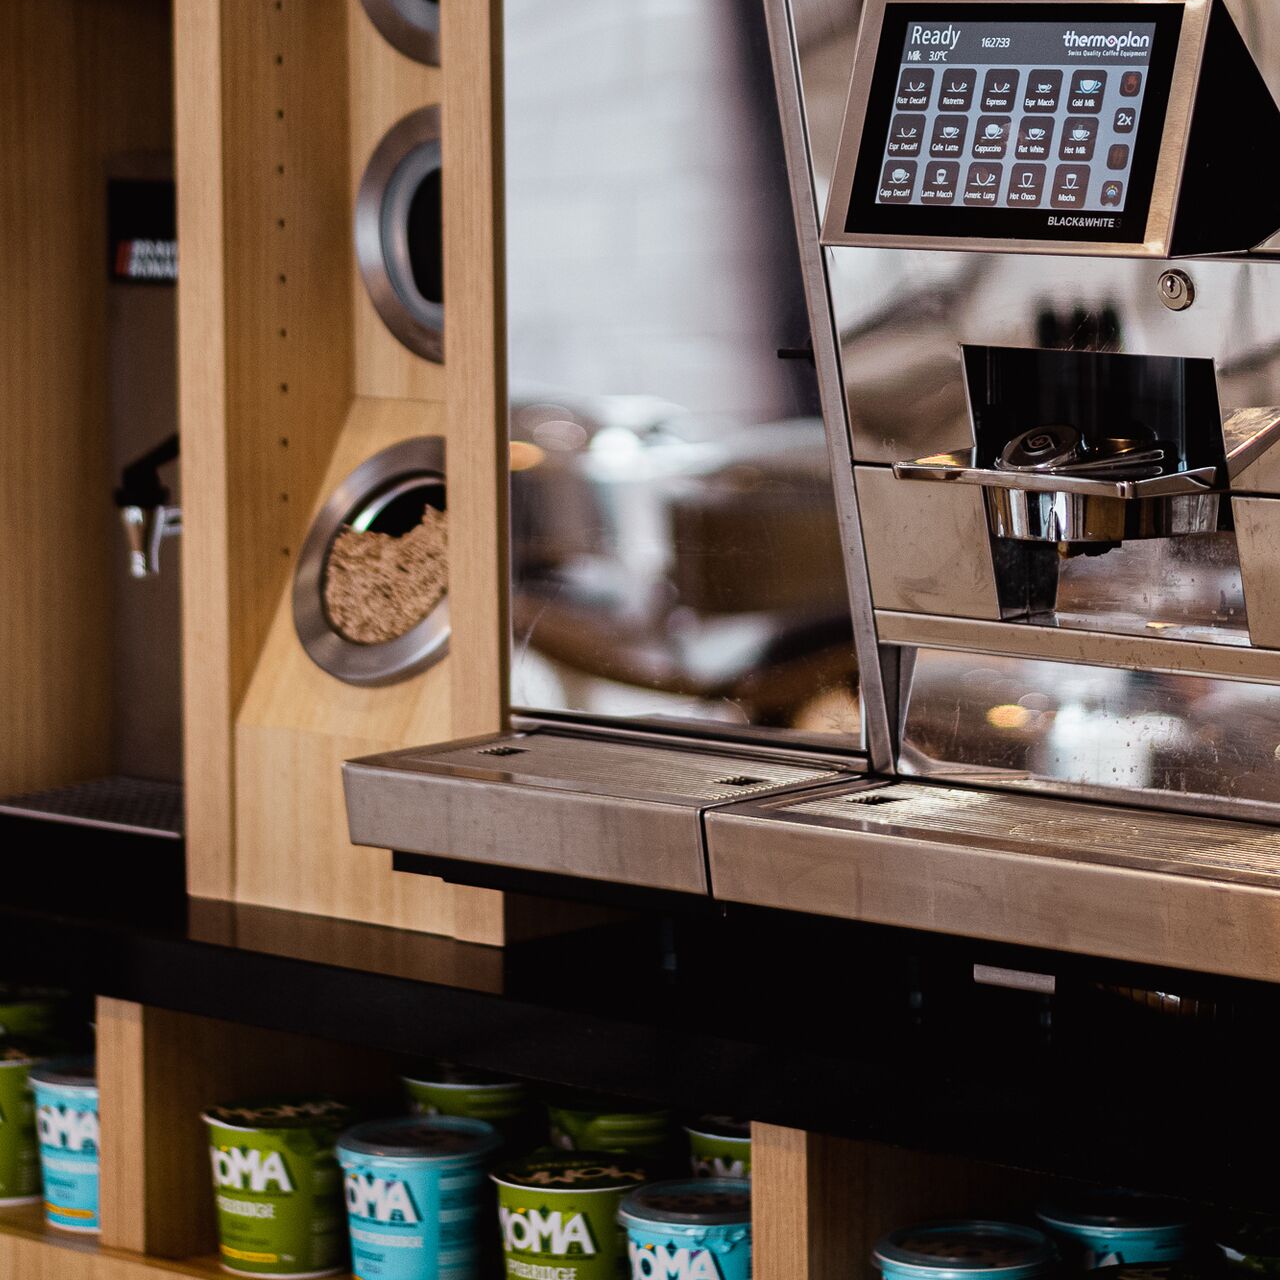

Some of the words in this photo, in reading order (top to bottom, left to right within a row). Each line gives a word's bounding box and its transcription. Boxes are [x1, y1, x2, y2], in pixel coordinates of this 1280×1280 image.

[911, 24, 961, 50] Ready
[1063, 30, 1150, 51] thermoplan
[1082, 49, 1102, 58] Quality
[1102, 49, 1119, 57] Coffee
[1119, 49, 1148, 58] Equipment
[909, 96, 927, 104] Decaff
[942, 97, 965, 105] Ristretto
[985, 97, 1007, 107] Espresso
[1037, 98, 1055, 106] Macch
[1072, 99, 1083, 107] Cold
[1084, 99, 1096, 107] Milk
[1116, 112, 1133, 126] 2x
[900, 142, 918, 150] Decaff
[931, 143, 943, 151] Cafe
[944, 143, 959, 151] Latte
[974, 144, 1002, 154] Cappuccino
[1018, 145, 1028, 153] Flat
[1029, 145, 1045, 154] White
[1064, 146, 1074, 154] Hot
[1075, 146, 1086, 154] Milk
[879, 188, 892, 198] Capp
[892, 188, 911, 197] Decaff
[936, 190, 953, 198] Macch
[982, 191, 996, 201] Lung
[1009, 192, 1019, 200] Hot
[1020, 192, 1036, 200] Choco
[1058, 193, 1076, 202] Mocha
[1047, 216, 1115, 228] BLACK&WHITE
